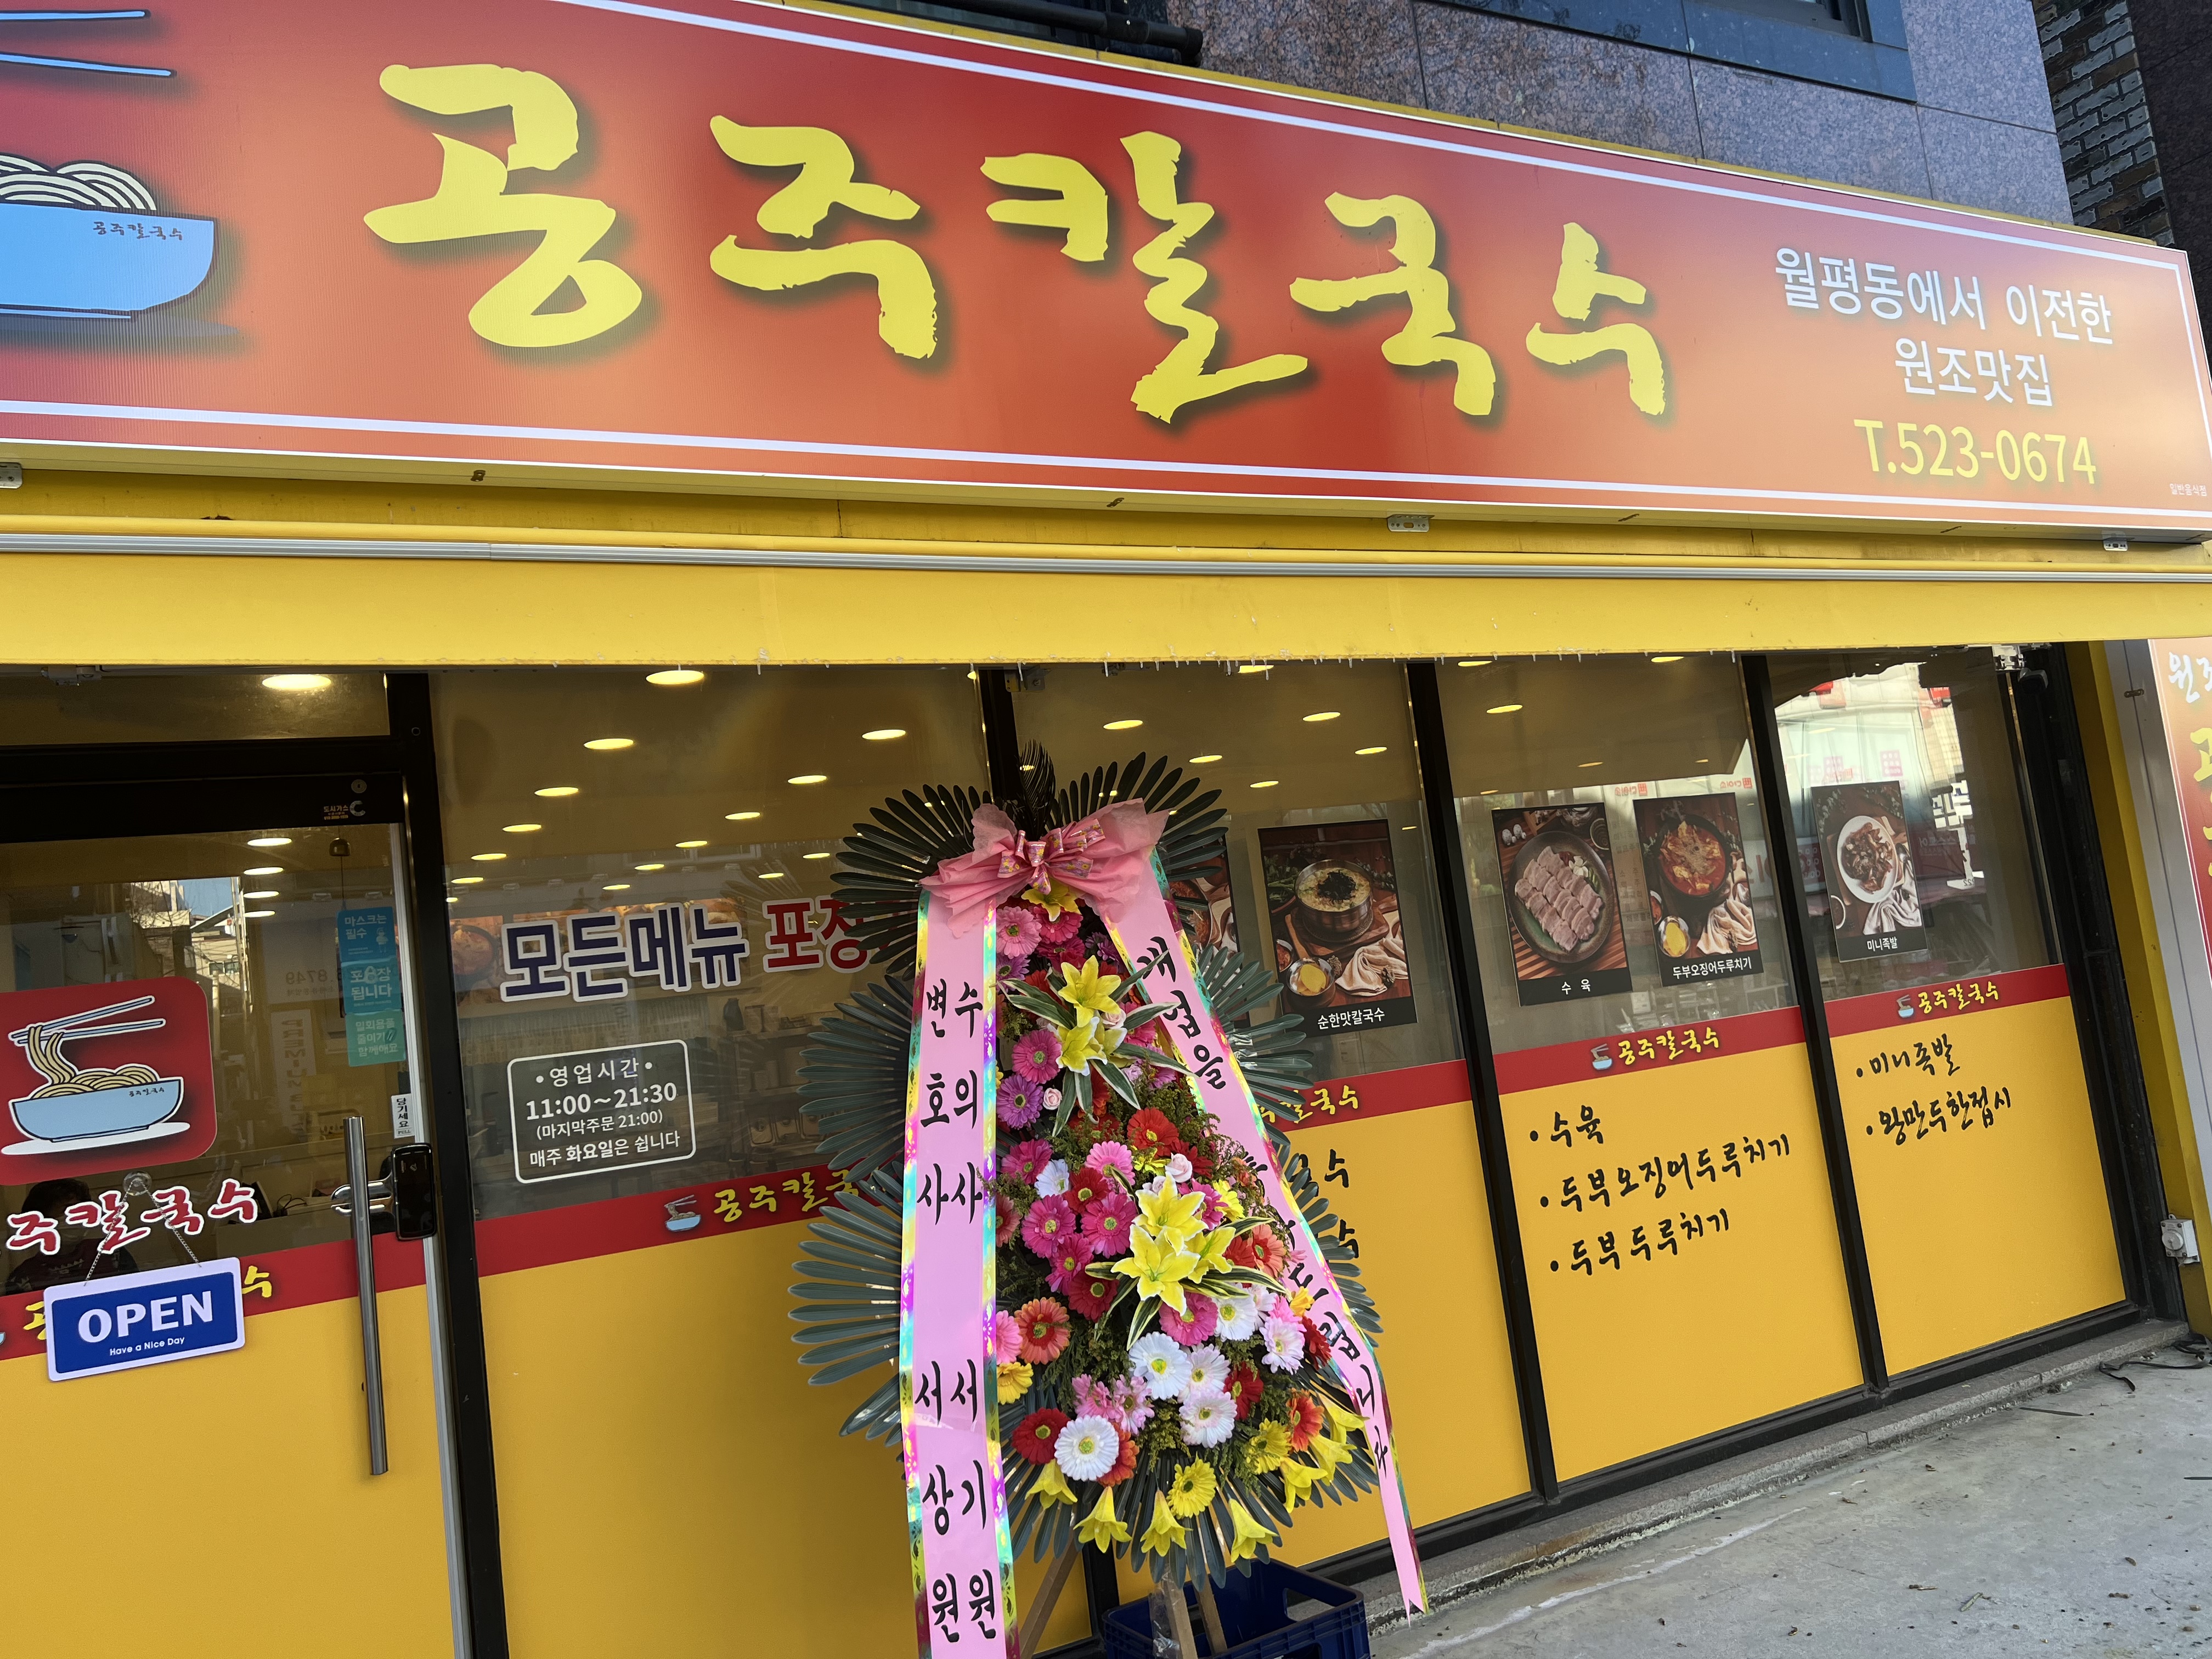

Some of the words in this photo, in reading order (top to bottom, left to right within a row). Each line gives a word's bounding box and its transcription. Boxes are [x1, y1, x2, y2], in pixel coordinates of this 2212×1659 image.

[93, 221, 183, 241] 공주칼국수
[364, 64, 1666, 424] 공주칼국수
[1775, 247, 1986, 330] 월평동에서
[2006, 284, 2113, 345] 이전한
[1894, 337, 2053, 407] 원조맛집
[1853, 418, 2097, 484] T.523-0674
[2170, 483, 2207, 496] 일반음식점
[345, 914, 387, 927] 마스크는
[345, 928, 367, 940] 필수
[500, 902, 750, 1002] 모든메뉴
[1866, 936, 1898, 952] 미니족발
[1672, 956, 1752, 980] 두부오징어두루치기
[351, 983, 392, 1001] 됩니다
[1917, 980, 2000, 1014] 공주칼국수
[1317, 1007, 1386, 1031] 순한맛칼국수
[1618, 1026, 1720, 1065] 공주칼국수
[1869, 1033, 1961, 1076] 미니족발
[129, 1087, 165, 1097] 공주칼국수
[396, 1097, 410, 1128] 당기세요
[526, 1082, 677, 1120] 11:00~21:30
[916, 978, 950, 1226] 변호사
[950, 981, 983, 1224] 수의사
[536, 1116, 615, 1141] (마지막주문
[618, 1109, 663, 1128] 21:00)
[1550, 1104, 1604, 1148] 수육
[1878, 1086, 2012, 1146] 왕만두한접시
[529, 1148, 562, 1167] 매주
[566, 1138, 629, 1163] 화요일은
[634, 1130, 680, 1153] 쉽니다
[1560, 1133, 1791, 1213] 두부오징어두루치기
[713, 1167, 878, 1223] 공주칼국
[4, 1178, 258, 1255] 주칼국수
[78, 1290, 213, 1344] OPEN
[109, 1345, 133, 1356] Have
[144, 1341, 165, 1350] Nice
[167, 1337, 185, 1346] Day
[915, 1361, 960, 1643] 서상원
[950, 1359, 996, 1640] 서기원
